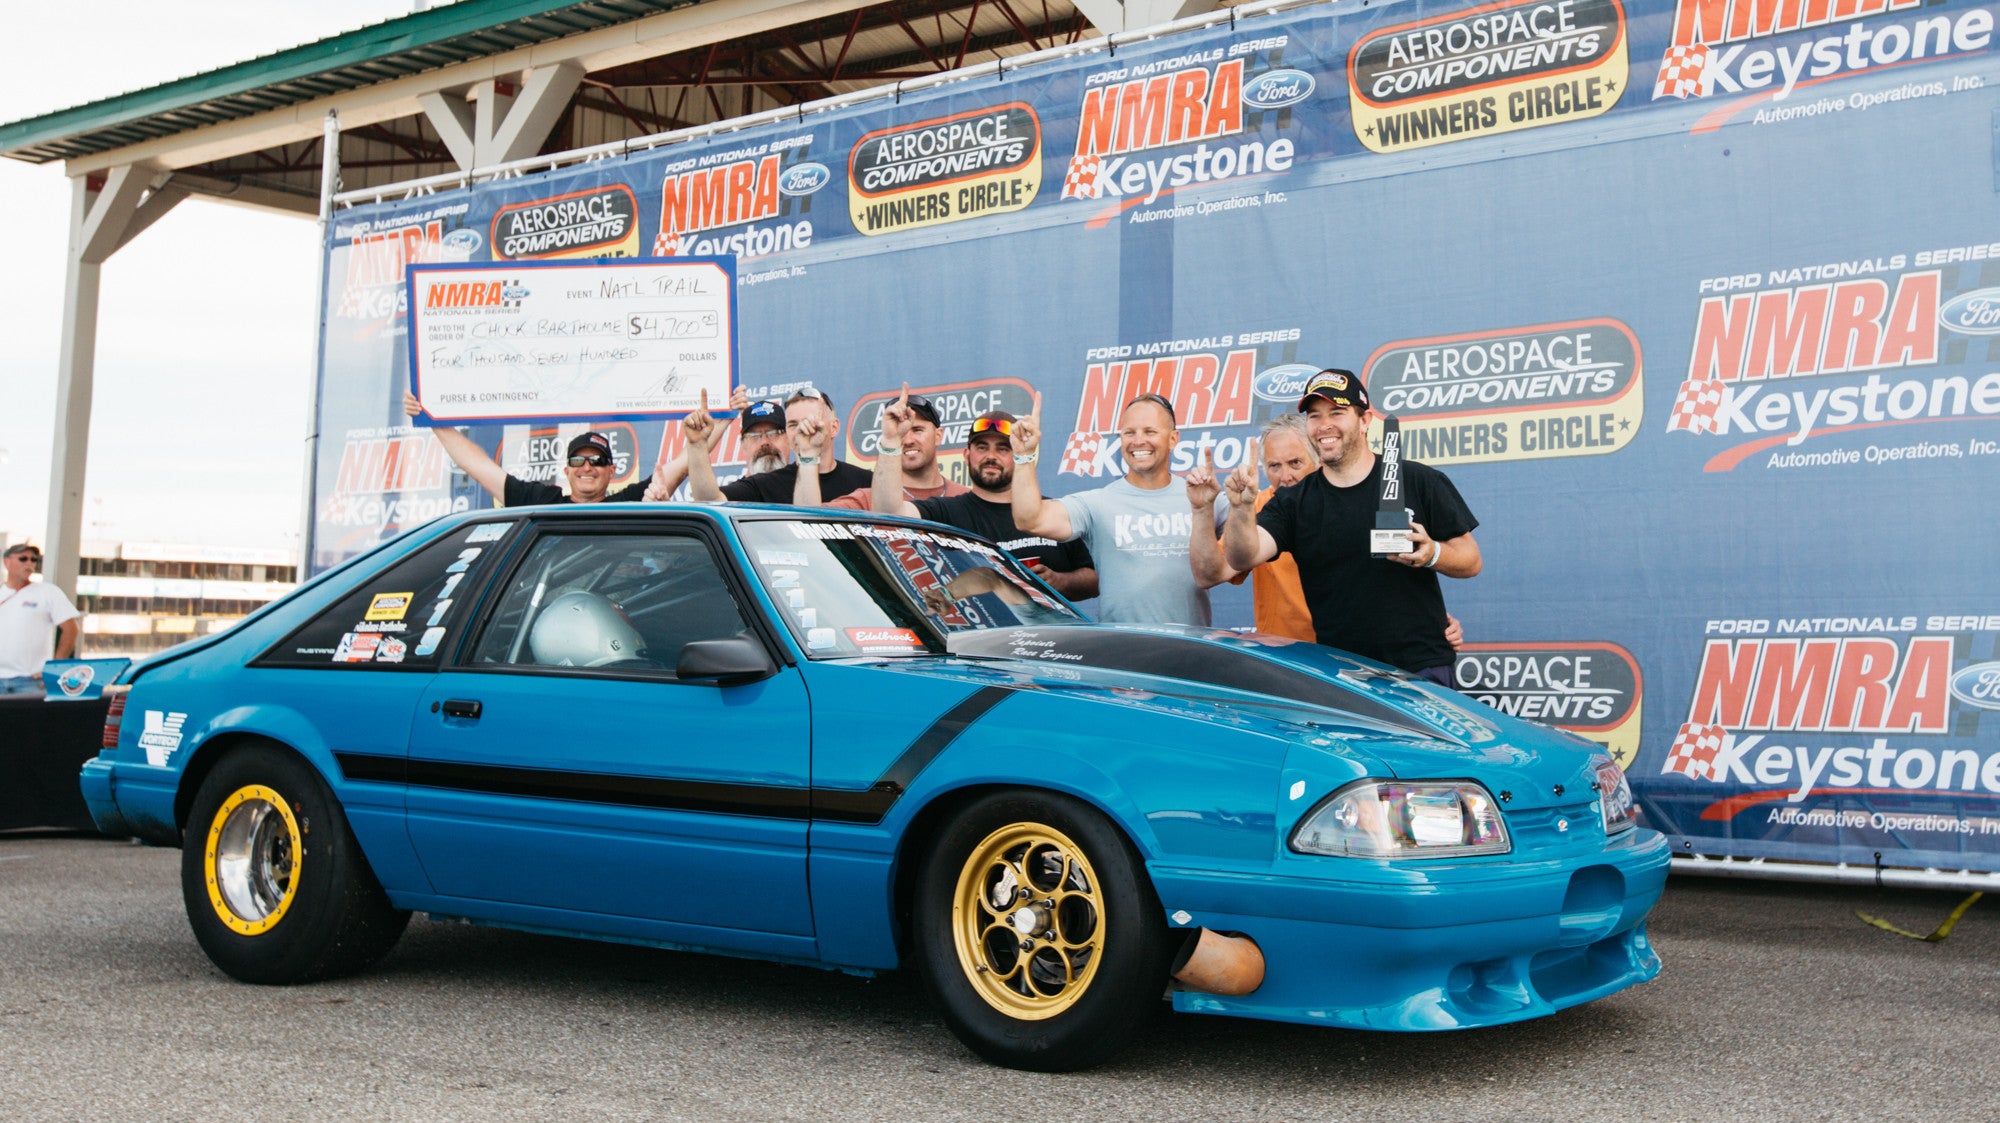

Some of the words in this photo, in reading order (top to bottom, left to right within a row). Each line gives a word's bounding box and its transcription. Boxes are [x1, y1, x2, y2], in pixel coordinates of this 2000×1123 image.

[1387, 1, 1576, 68] AEROSPACE
[1700, 8, 1994, 102] Keystone
[1085, 70, 1128, 87] FORD
[1131, 48, 1223, 77] NATIONALS
[1227, 35, 1289, 58] SERIES
[1372, 33, 1600, 98] COMPONENTS
[1075, 57, 1245, 157] NMRA
[1256, 76, 1301, 102] Ford
[1753, 97, 1846, 126] Automotive
[1849, 79, 1948, 111] Operations,
[1952, 75, 1986, 92] Inc.
[1376, 96, 1497, 147] WINNERS
[1508, 76, 1602, 123] CIRCLE
[665, 158, 697, 174] FORD
[699, 144, 769, 166] NATIONALS
[770, 134, 814, 151] SERIES
[876, 115, 1009, 165] AEROSPACE
[787, 170, 819, 190] Ford
[863, 142, 1025, 189] COMPONENTS
[1095, 138, 1295, 205] Keystone
[660, 152, 781, 235] NMRA
[866, 191, 951, 230] WINNERS
[958, 178, 1023, 215] CIRCLE
[1129, 202, 1195, 224] Automotive
[1196, 196, 1262, 216] Operations,
[1264, 190, 1288, 205] Inc.
[511, 195, 614, 235] AEROSPACE
[504, 219, 624, 256] COMPONENTS
[746, 267, 790, 285] Operations,
[791, 265, 807, 277] Inc.
[1699, 273, 1761, 294] FORD
[1768, 254, 1907, 286] NATIONALS
[1915, 242, 2000, 267] SERIES
[427, 281, 502, 309] NMRA
[567, 290, 593, 299] EVENT
[1960, 297, 2000, 326] For
[428, 325, 442, 333] PAY
[452, 324, 465, 332] THE
[428, 333, 454, 342] ORDER
[455, 333, 465, 341] OF
[1086, 345, 1132, 361] FORD
[1136, 335, 1233, 356] NATIONALS
[1238, 328, 1301, 345] SERIES
[1688, 269, 1942, 384] NMRA
[679, 352, 717, 361] DOLLARS
[1401, 333, 1592, 383] AEROSPACE
[440, 393, 467, 403] PURSE
[470, 394, 476, 402] &
[480, 391, 539, 402] CONTINGENCY
[1075, 348, 1257, 436] NMRA
[1382, 369, 1616, 412] COMPONENTS
[1716, 373, 2000, 446] Keystone
[1520, 413, 1615, 453] CIRCLE
[335, 435, 445, 494] NMRA
[1383, 431, 1399, 500] NMRA
[1767, 451, 1861, 470] Automotive
[1864, 441, 1964, 464] Operations,
[1968, 438, 2000, 456] Inc.
[855, 631, 915, 643] Edelbrock
[1705, 619, 1770, 634] FORD
[1776, 616, 1918, 633] NATIONALS
[1925, 615, 2000, 631] SERIE
[1455, 656, 1592, 689] OSPACE
[1687, 635, 1954, 734] NMRA
[1767, 808, 1866, 829] Automotive
[1869, 812, 1975, 837] Operations,
